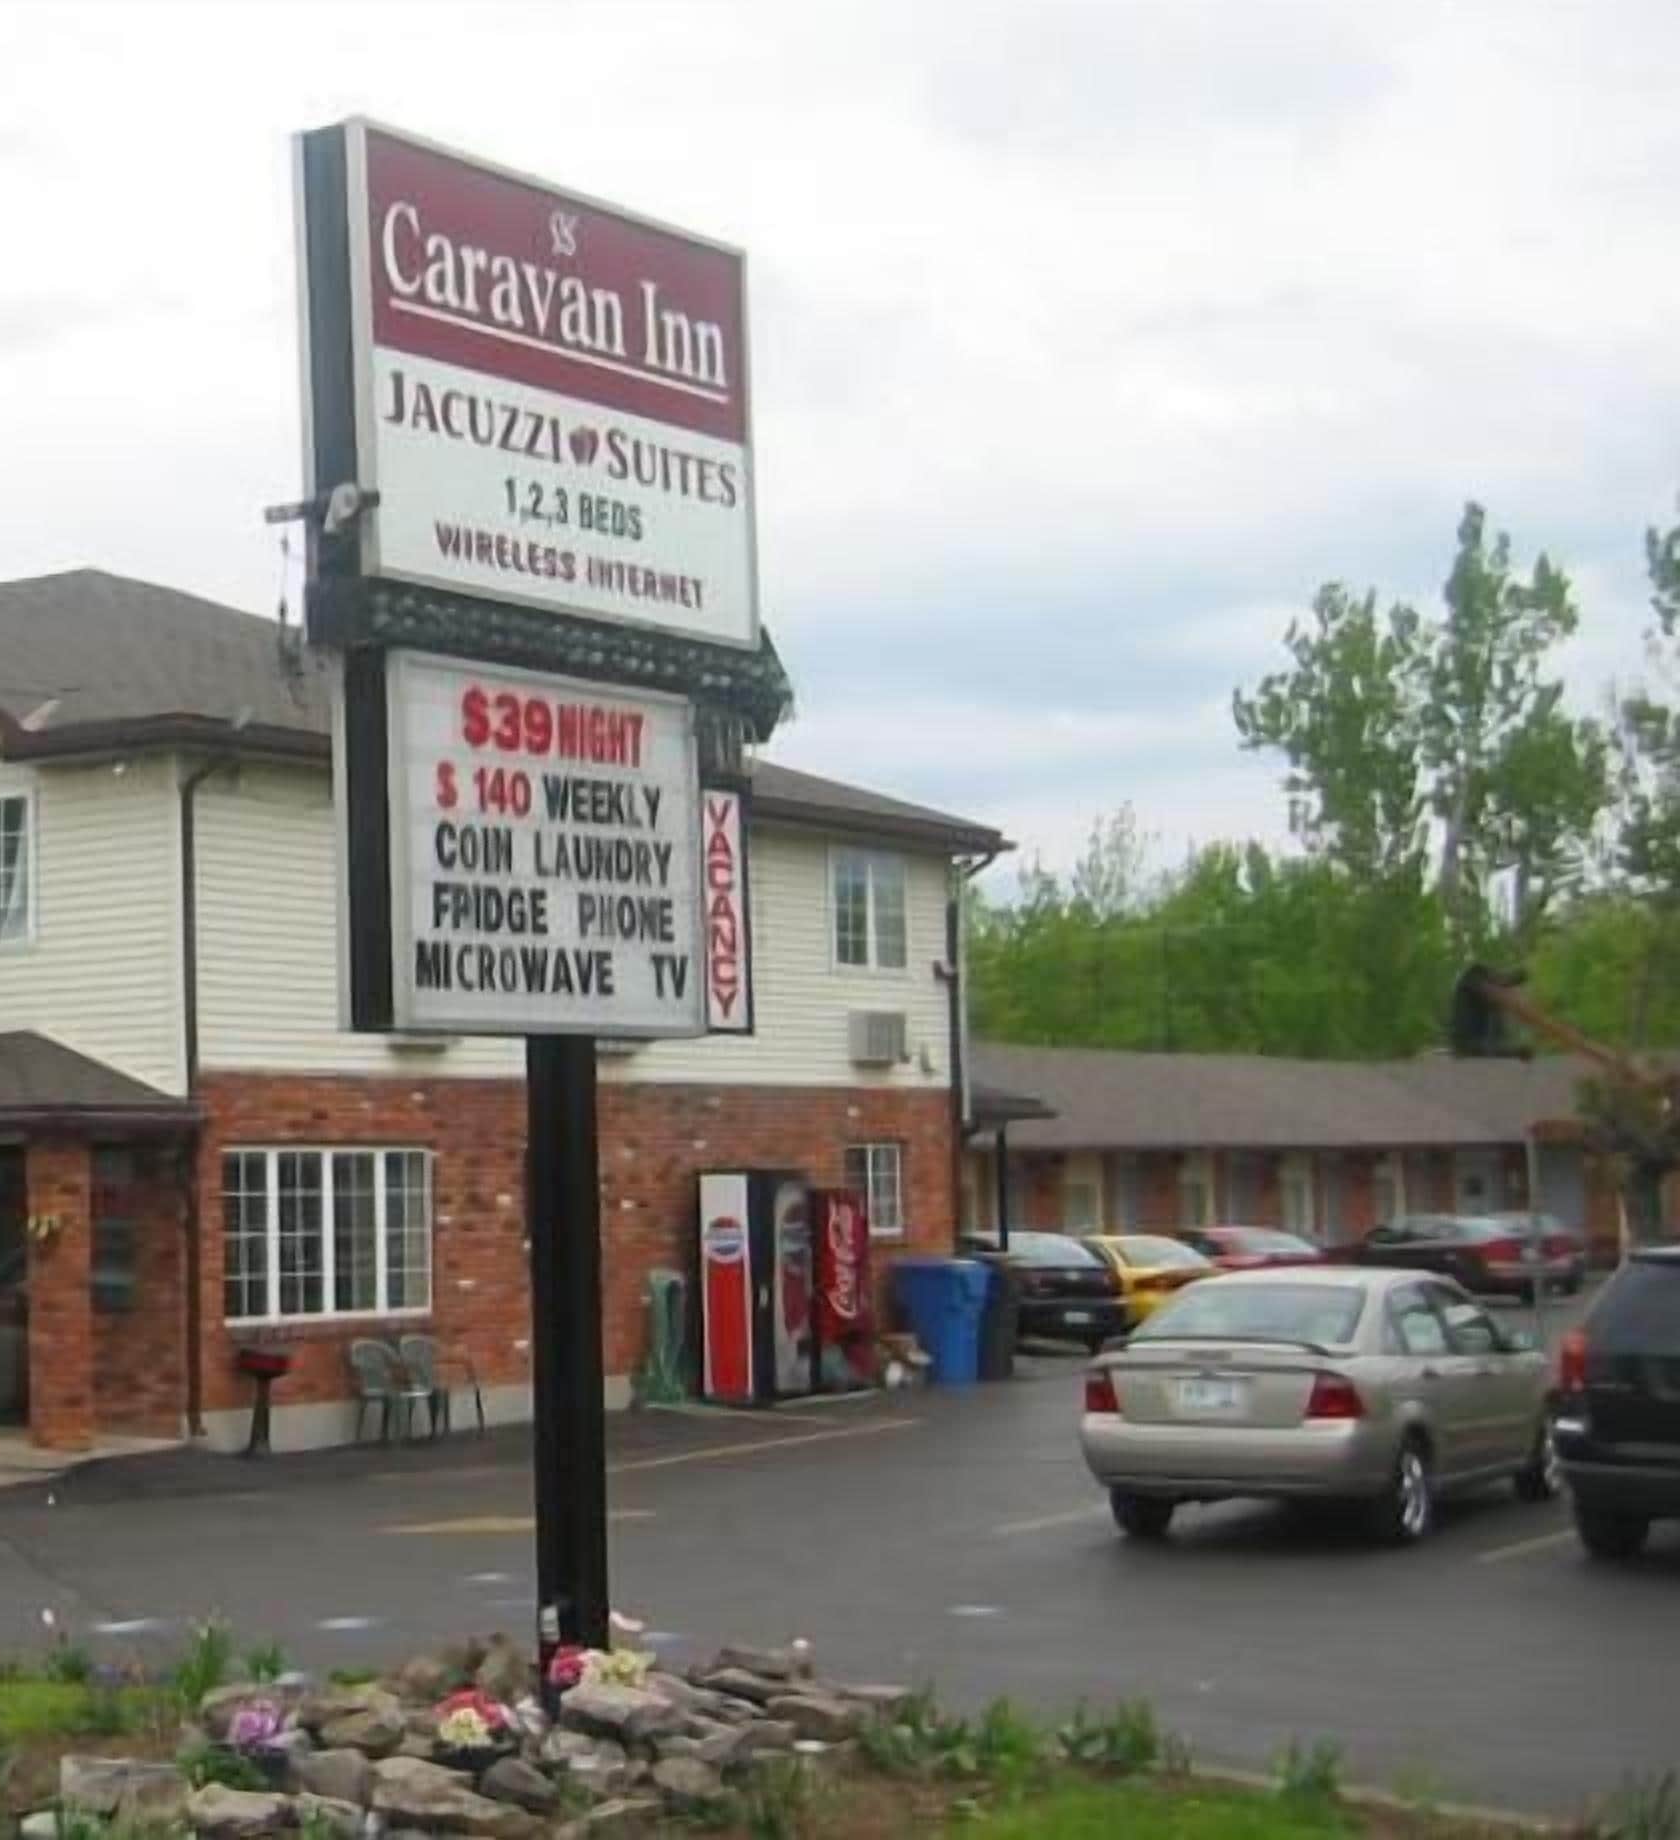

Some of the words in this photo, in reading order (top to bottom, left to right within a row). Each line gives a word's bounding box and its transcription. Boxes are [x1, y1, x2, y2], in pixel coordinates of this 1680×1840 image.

[382, 201, 625, 357] Caravan
[641, 281, 728, 387] Inn
[384, 371, 562, 463] JACUZZI
[607, 432, 737, 507] SUITES
[579, 492, 643, 541] BEDS
[434, 520, 576, 582] WIRELESS
[587, 556, 703, 609] INTERNET
[462, 685, 553, 754] $39
[557, 702, 645, 768] NIGHT
[436, 762, 458, 809] $
[473, 766, 532, 817] 140
[542, 775, 661, 829] WEEKLY
[435, 823, 513, 873] COIN
[534, 832, 672, 886] LAUNDRY
[578, 893, 675, 943] PHONE
[707, 801, 737, 1019] VACANCY
[415, 940, 615, 995] MICROWAVE
[651, 953, 689, 999] TV
